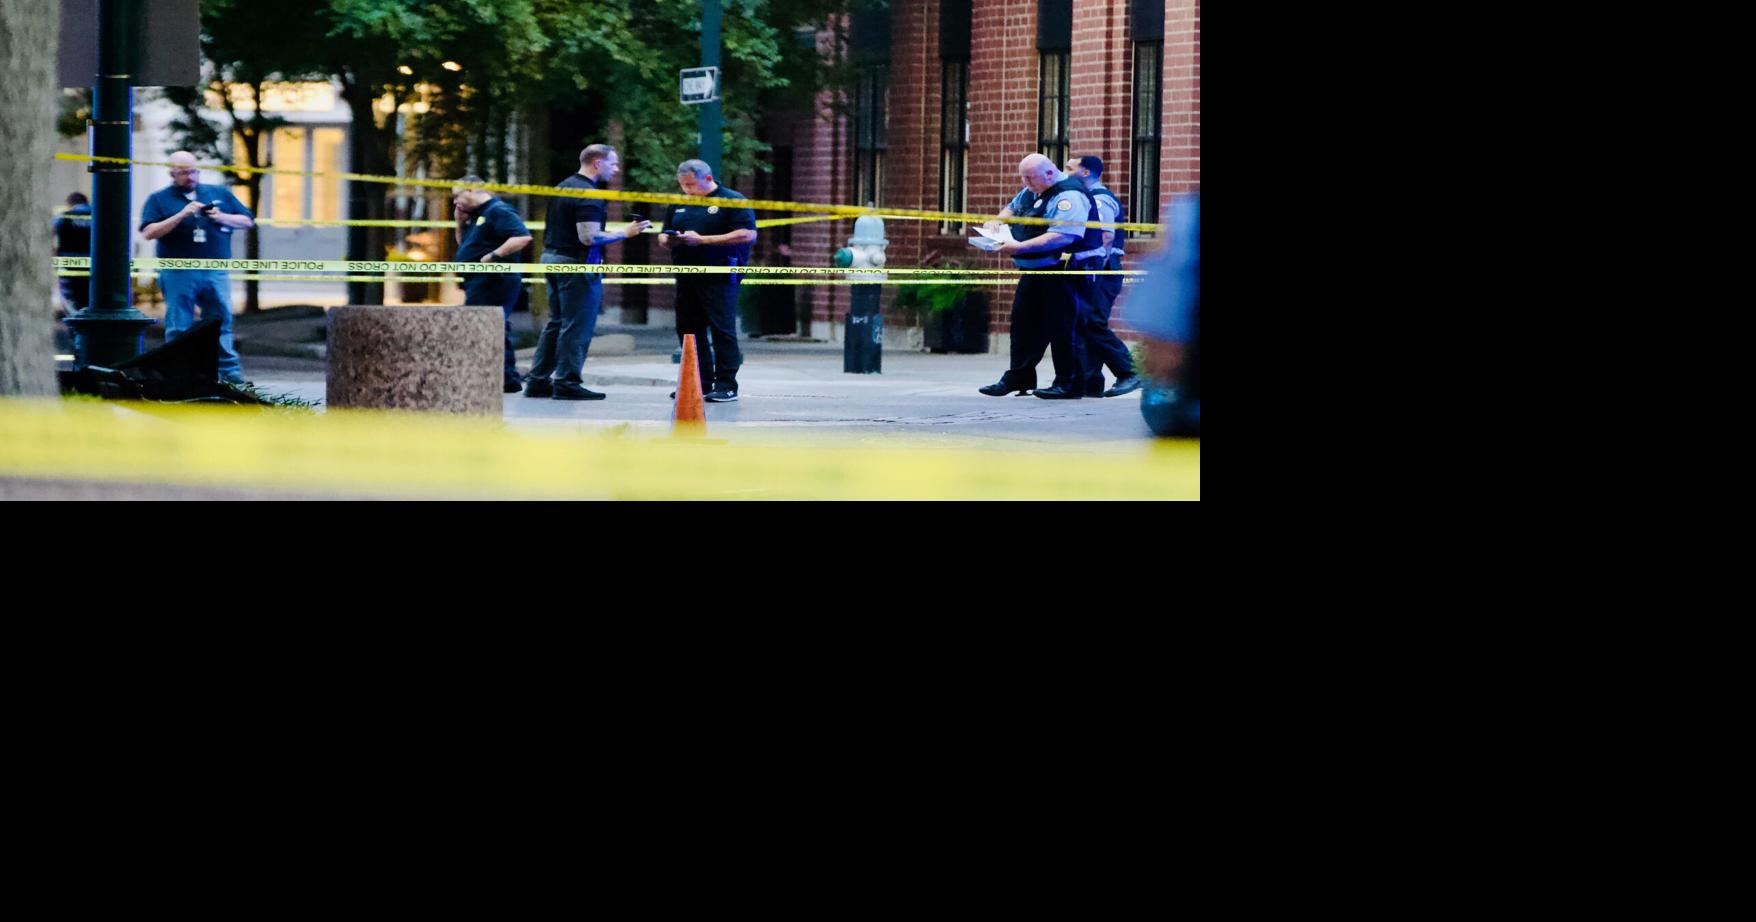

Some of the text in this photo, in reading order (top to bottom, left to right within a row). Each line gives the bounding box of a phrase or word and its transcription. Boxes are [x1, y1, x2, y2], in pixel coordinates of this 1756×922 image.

[159, 259, 324, 270] POLICE LINE DO NOT CROSS
[348, 262, 389, 270] CROSS
[394, 263, 416, 271] NOT
[419, 263, 437, 271] DO
